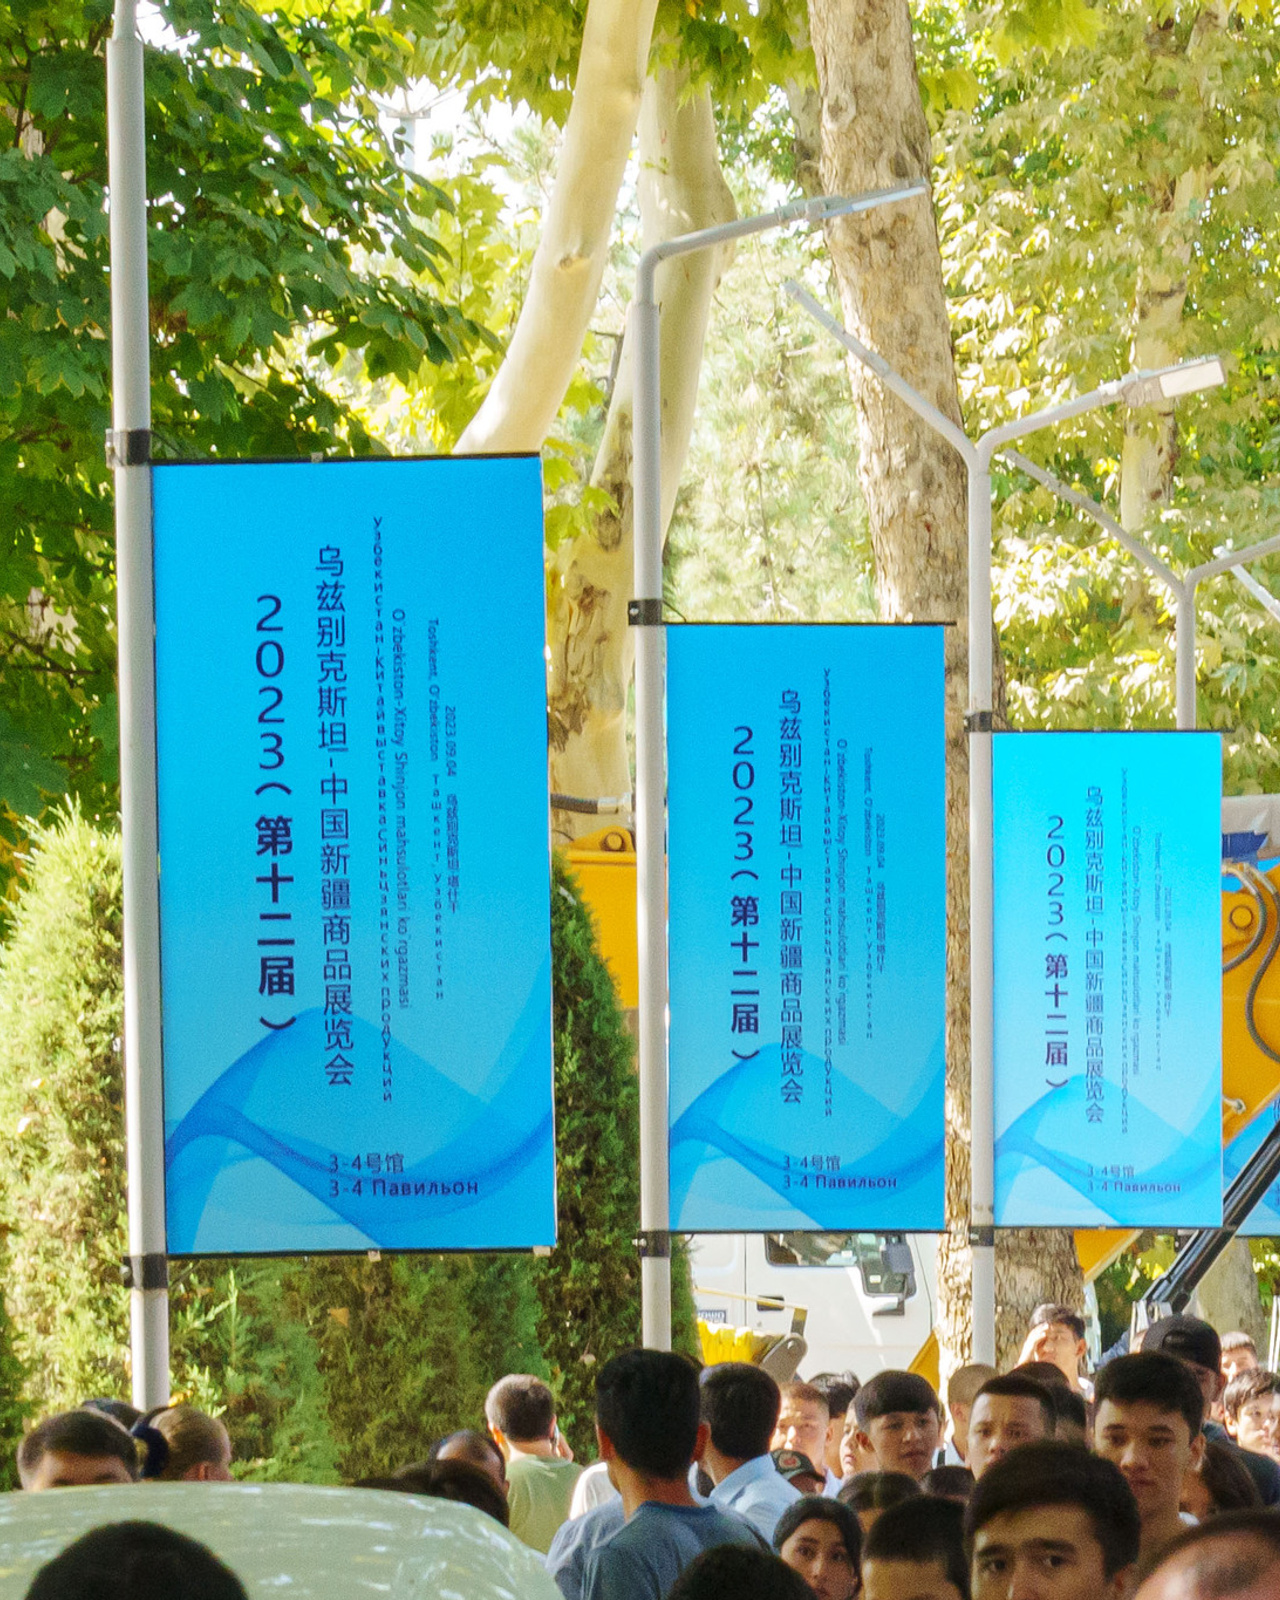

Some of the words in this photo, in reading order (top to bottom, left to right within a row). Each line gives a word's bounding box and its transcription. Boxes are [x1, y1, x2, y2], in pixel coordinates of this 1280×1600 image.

[391, 751, 408, 811] Shinjon
[395, 815, 410, 911] mahsulotlari
[330, 1179, 362, 1197] 3-4
[373, 1179, 478, 1196] Павильон
[815, 1175, 897, 1189] Павильон
